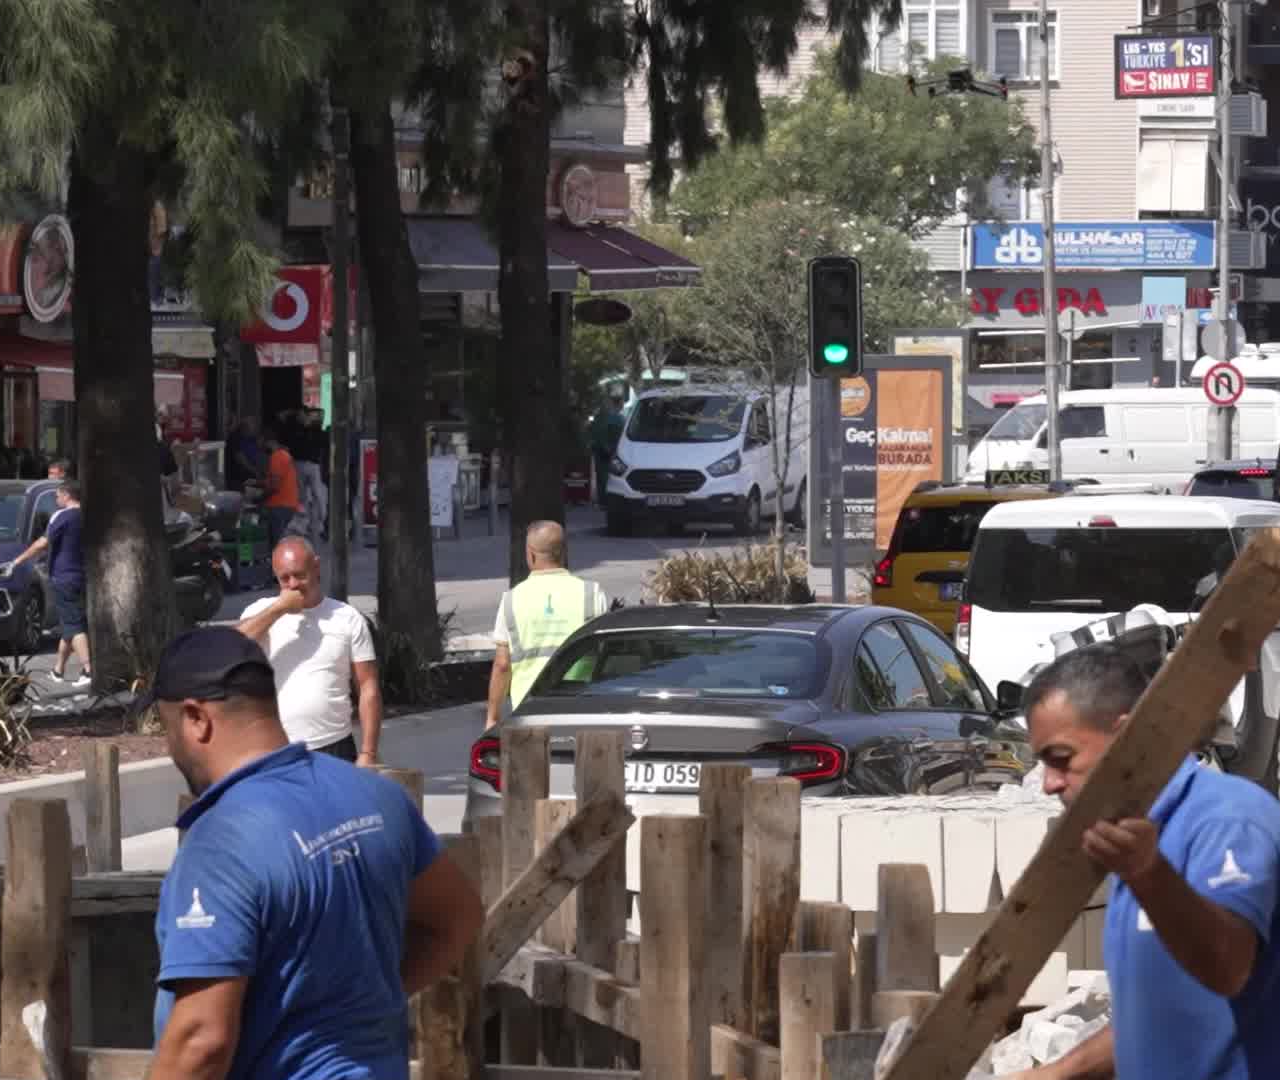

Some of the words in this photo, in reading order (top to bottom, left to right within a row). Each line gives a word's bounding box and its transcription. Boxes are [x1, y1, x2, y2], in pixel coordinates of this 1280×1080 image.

[1014, 287, 1108, 316] GDA
[845, 427, 876, 448] Geç
[878, 453, 933, 465] BURADA
[663, 763, 700, 784] 059
